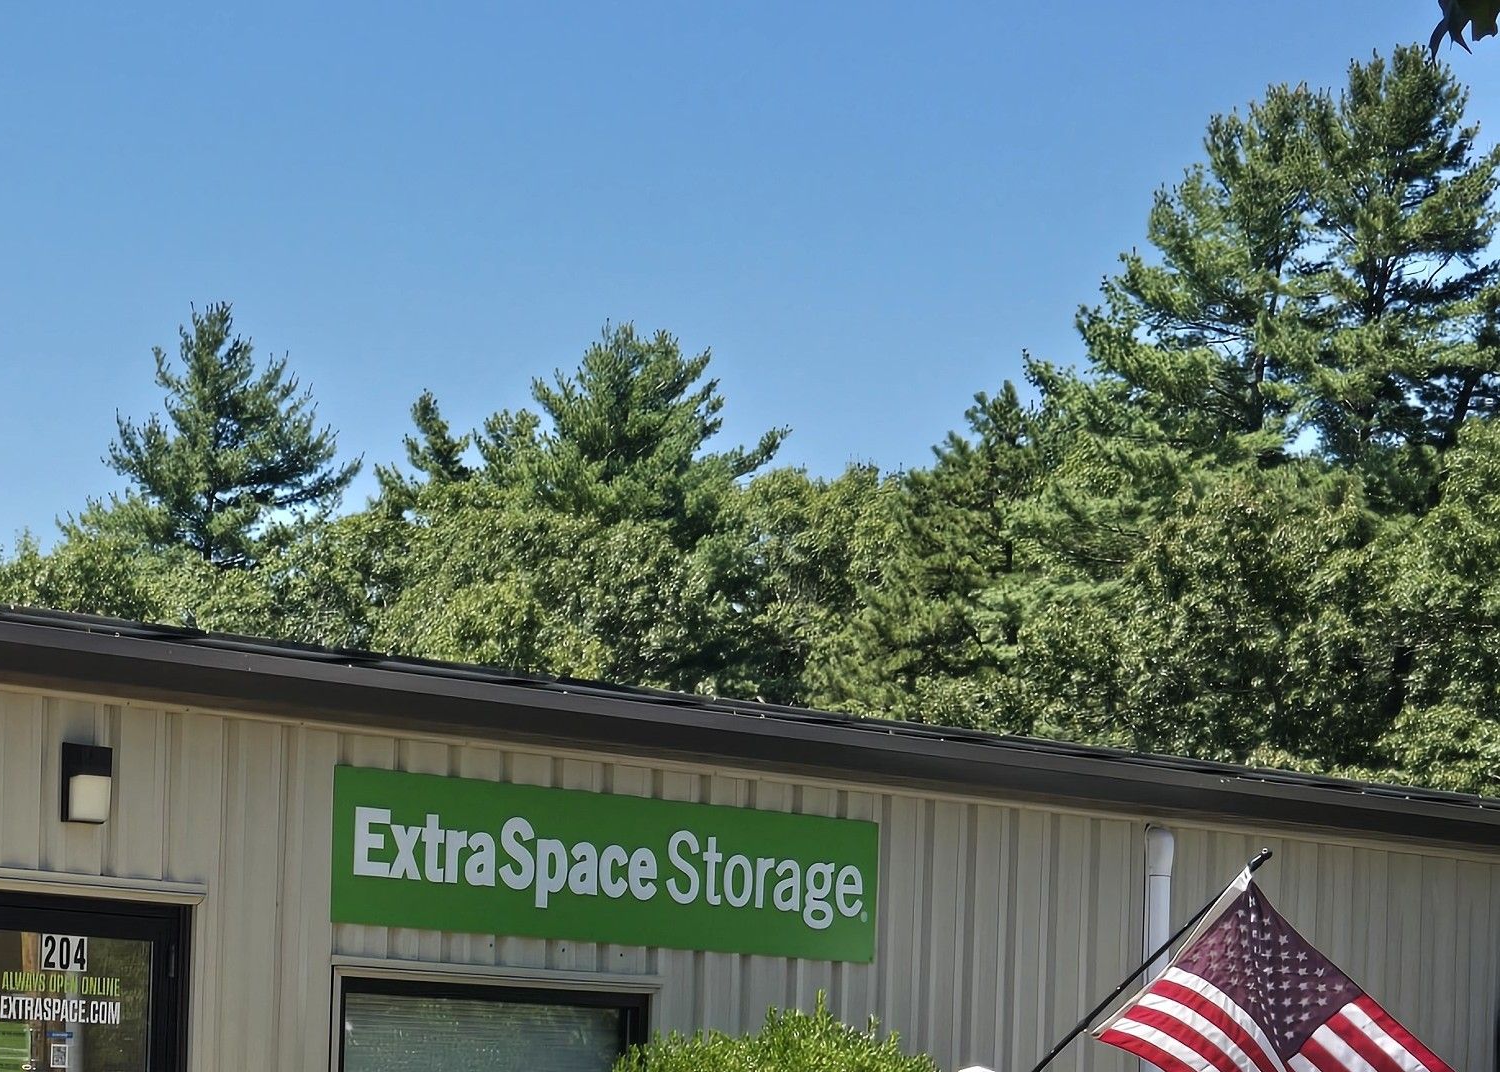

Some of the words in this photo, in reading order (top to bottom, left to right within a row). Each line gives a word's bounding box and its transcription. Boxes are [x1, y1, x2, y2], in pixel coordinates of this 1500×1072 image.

[665, 829, 864, 930] Storage
[43, 935, 86, 971] 204
[1, 970, 46, 992] ALWAYS
[49, 973, 79, 995] OPEN
[81, 976, 121, 997] ONLINE
[0, 995, 121, 1025] EXTRASPACE.COM
